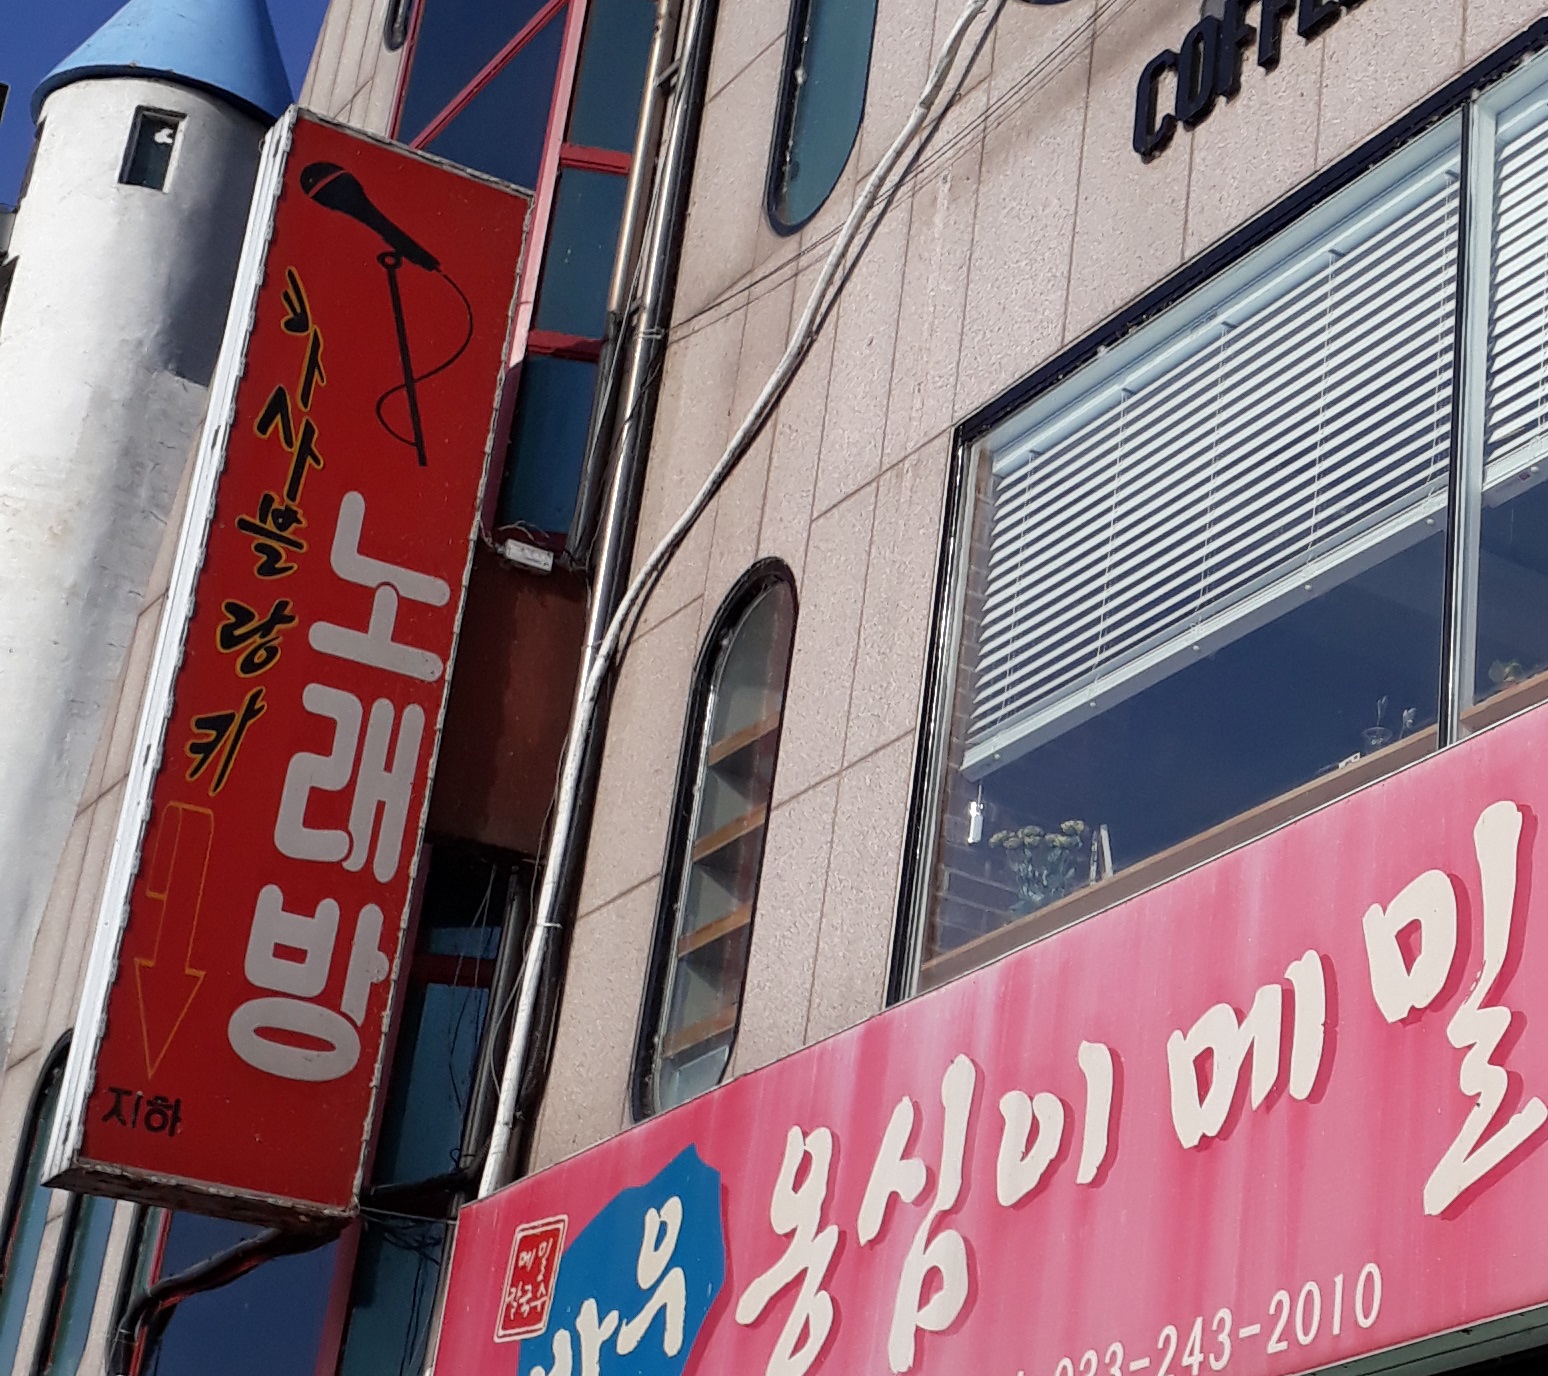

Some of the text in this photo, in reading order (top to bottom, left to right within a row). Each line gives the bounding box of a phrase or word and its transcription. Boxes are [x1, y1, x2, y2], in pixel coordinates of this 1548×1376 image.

[228, 491, 451, 1082] 노래방
[102, 1086, 182, 1138] 지하
[518, 1237, 554, 1283] 메밀
[505, 1281, 548, 1321] 칼국수
